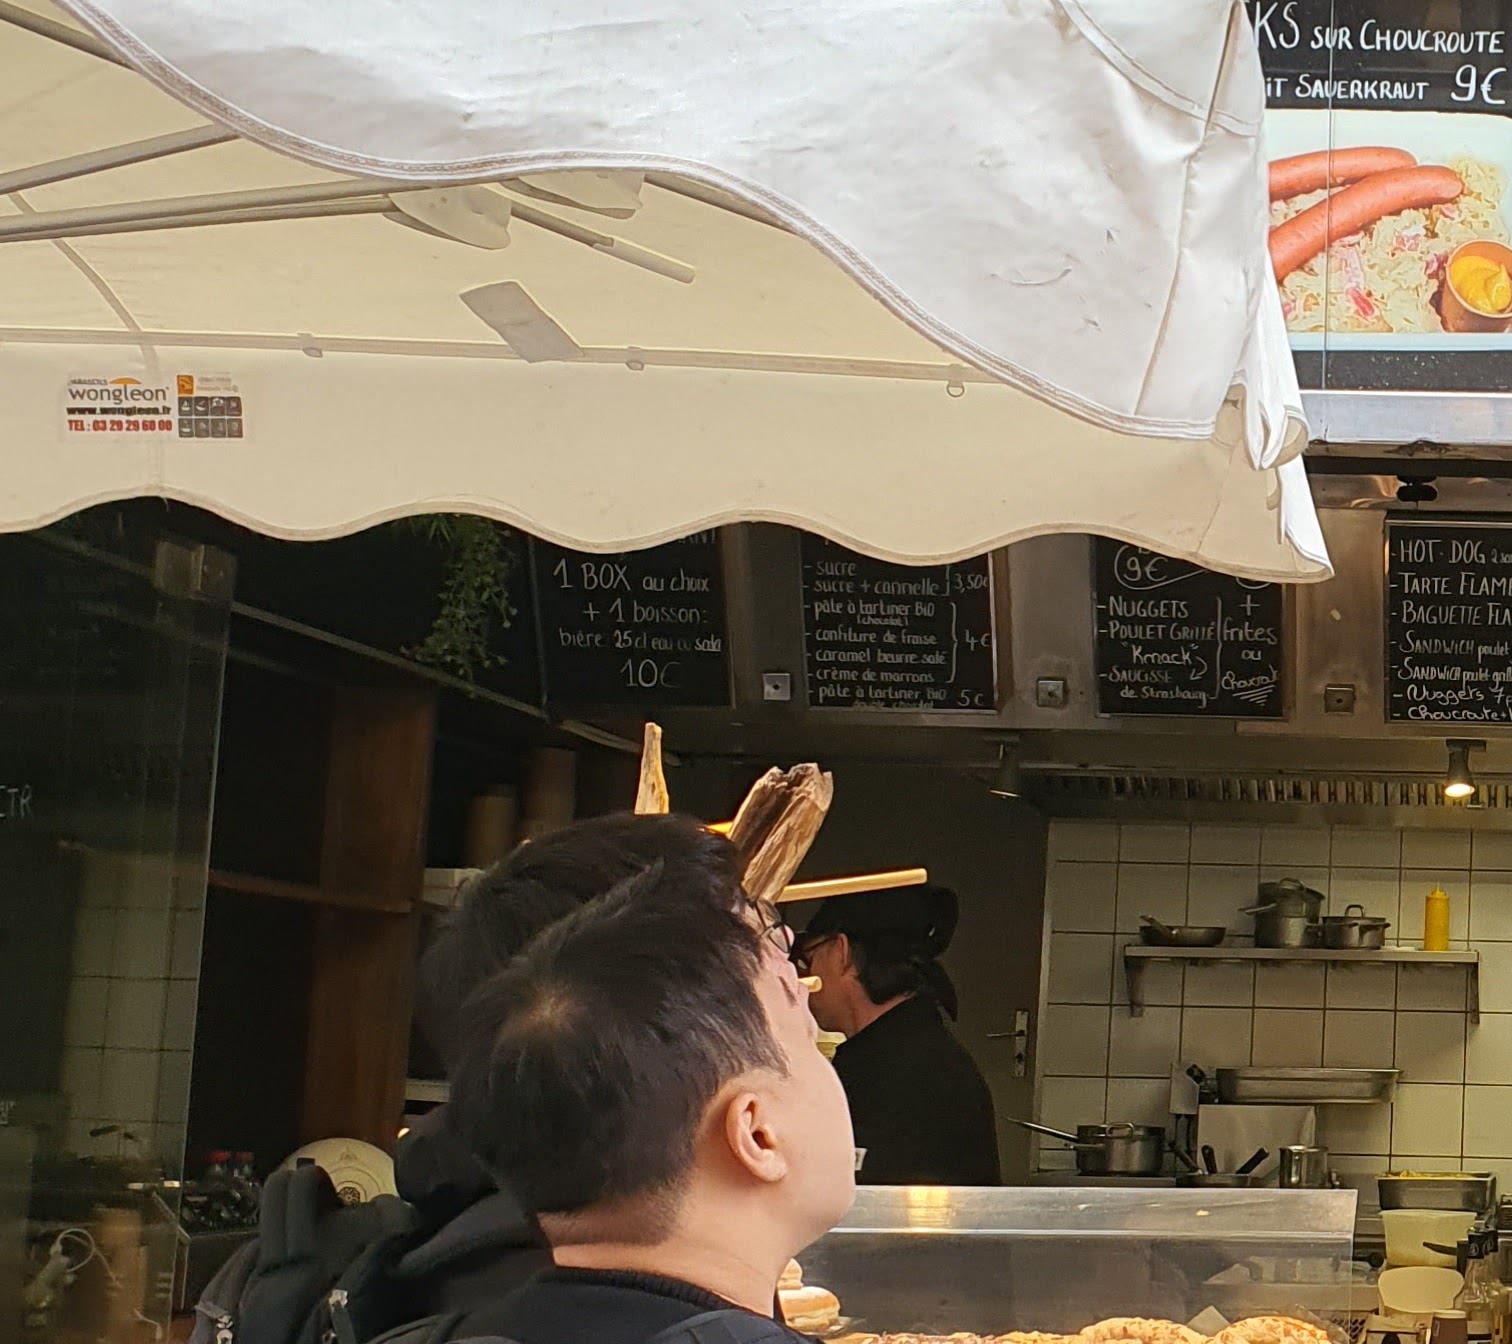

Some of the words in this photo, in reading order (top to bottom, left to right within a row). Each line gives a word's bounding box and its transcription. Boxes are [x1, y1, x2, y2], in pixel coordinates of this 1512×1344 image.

[1310, 26, 1353, 50] SUR
[1360, 19, 1505, 53] CHOUCROUTE
[1296, 74, 1429, 100] SAUERKRAUT
[1450, 64, 1507, 104] 9€
[68, 387, 167, 404] wongleon
[582, 563, 631, 591] BOX
[643, 576, 664, 591] au
[816, 561, 856, 576] sucre
[1123, 557, 1168, 581] 9€
[815, 580, 853, 592] sucre
[874, 578, 939, 595] cannelle
[1399, 572, 1451, 595] TARTE
[1109, 596, 1188, 618] NUGGETS
[1402, 601, 1482, 625] BAGUETTE
[1109, 620, 1165, 640] POULET
[1223, 617, 1277, 645] frites
[816, 648, 871, 662] caramel
[1241, 650, 1262, 660] ou
[1121, 688, 1138, 698] de
[1407, 685, 1484, 705] Nuggets
